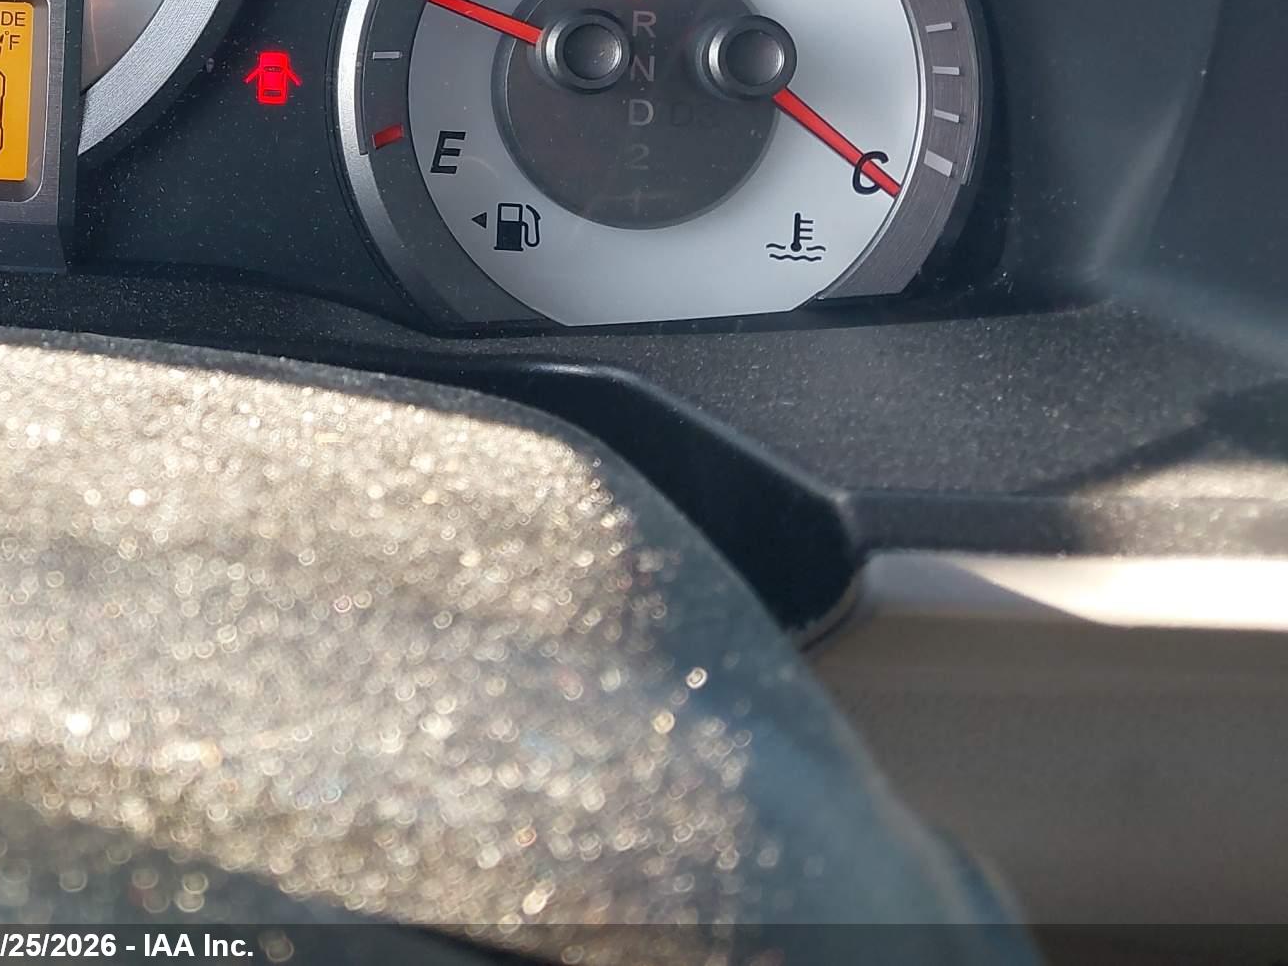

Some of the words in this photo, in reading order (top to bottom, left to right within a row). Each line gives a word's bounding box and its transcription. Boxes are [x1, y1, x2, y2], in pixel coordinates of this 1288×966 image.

[632, 10, 657, 38] R
[629, 55, 656, 82] N
[628, 98, 655, 126] D
[429, 130, 466, 173] E
[629, 143, 650, 170] 2
[851, 151, 890, 195] C
